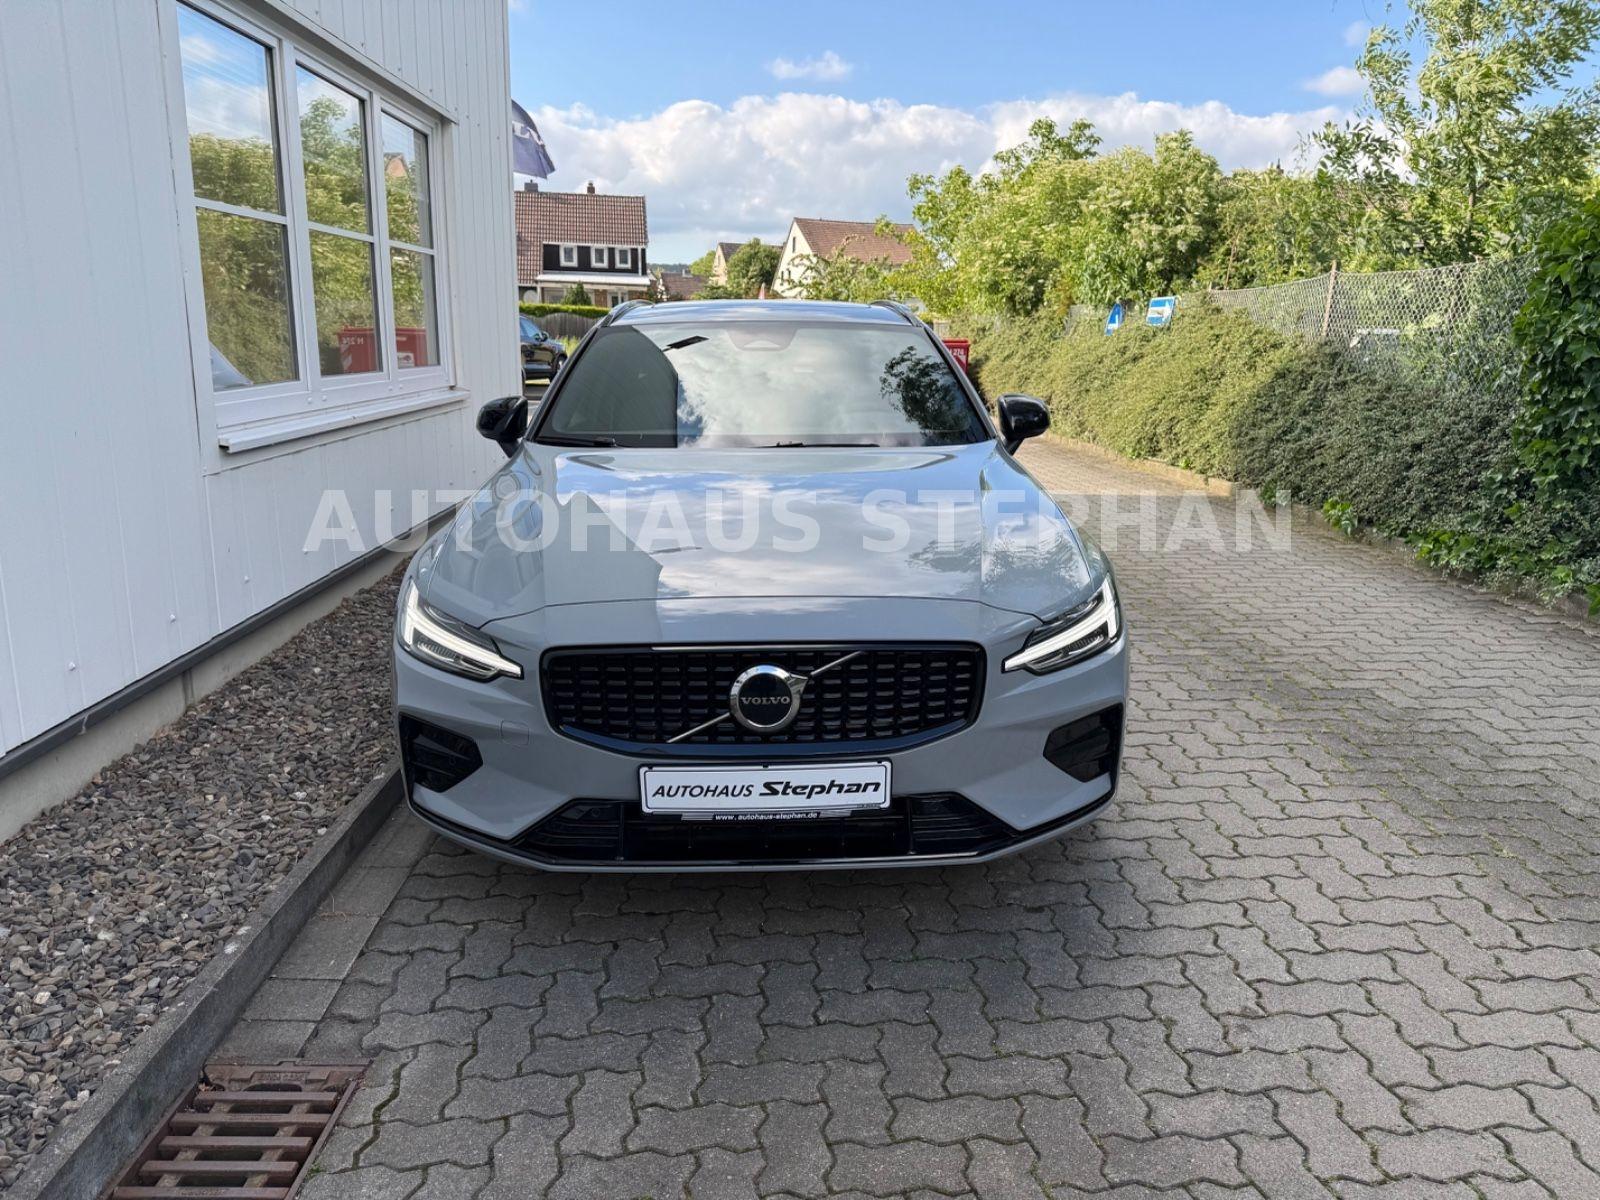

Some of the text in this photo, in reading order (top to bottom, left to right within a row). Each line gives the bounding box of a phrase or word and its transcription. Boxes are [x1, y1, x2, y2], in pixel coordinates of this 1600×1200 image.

[740, 696, 791, 705] VOLVO
[652, 779, 881, 800] AUTOHAUS Stephan
[715, 812, 818, 821] www.autohaus-stephan.de
